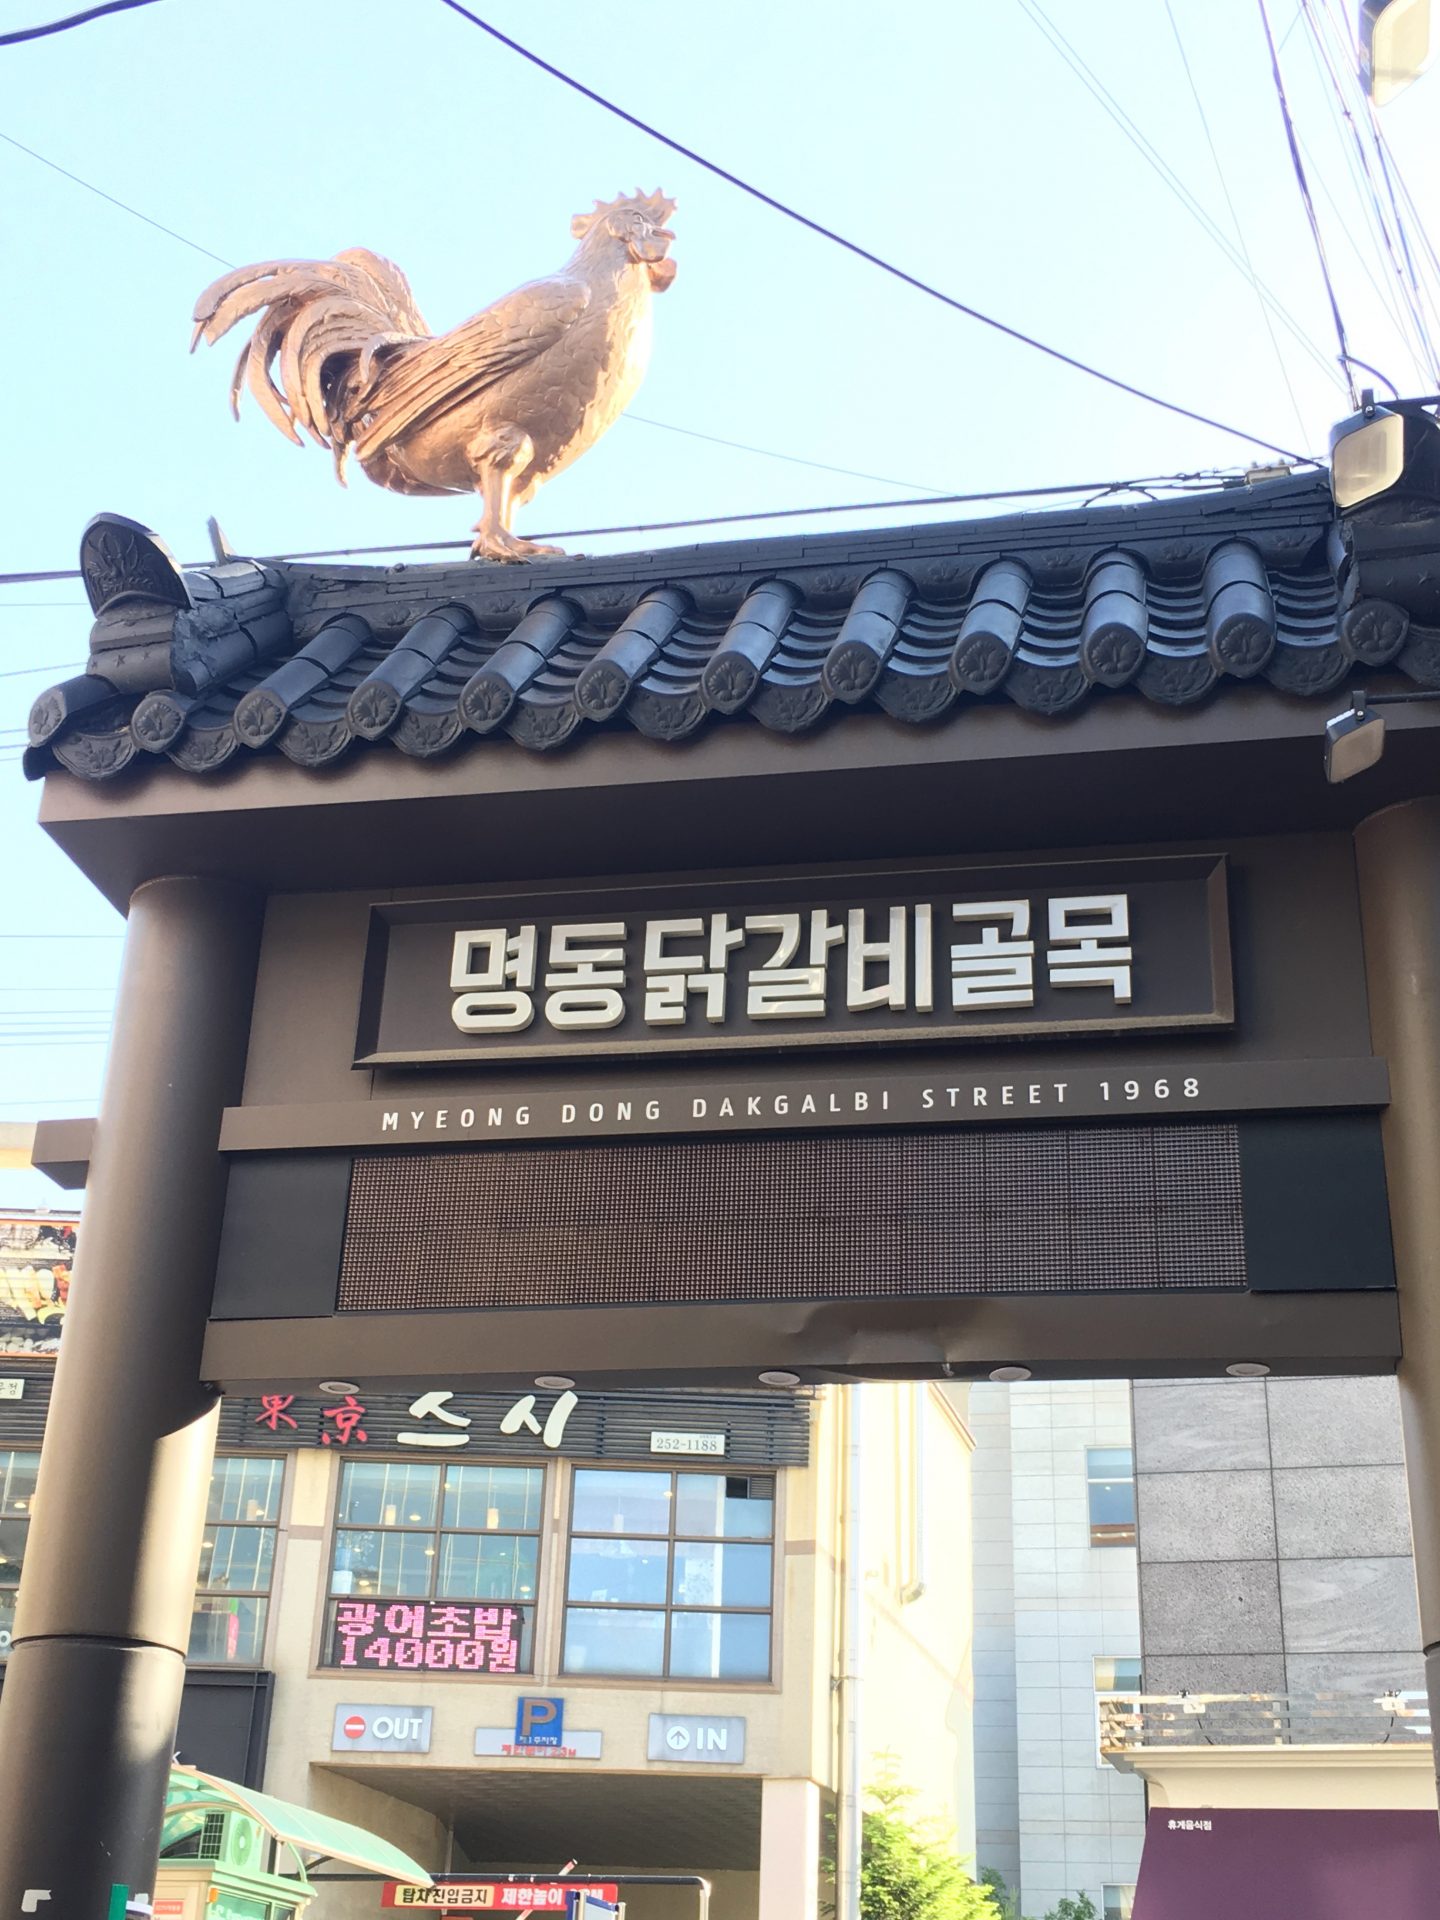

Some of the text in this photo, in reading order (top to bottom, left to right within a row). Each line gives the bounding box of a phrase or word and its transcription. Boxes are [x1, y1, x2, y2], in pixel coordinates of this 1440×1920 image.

[381, 1077, 1199, 1132] MYEONG DONG DAKGALBI STREET 1968
[656, 1437, 718, 1452] 252-1188
[337, 1602, 518, 1640] 광어초밥
[340, 1636, 518, 1673] 14000원
[372, 1716, 423, 1740] OUT
[520, 1698, 558, 1736] P
[696, 1727, 728, 1751] IN
[1167, 1819, 1213, 1831] 휴게음식점
[501, 1887, 562, 1906] 제한높이
